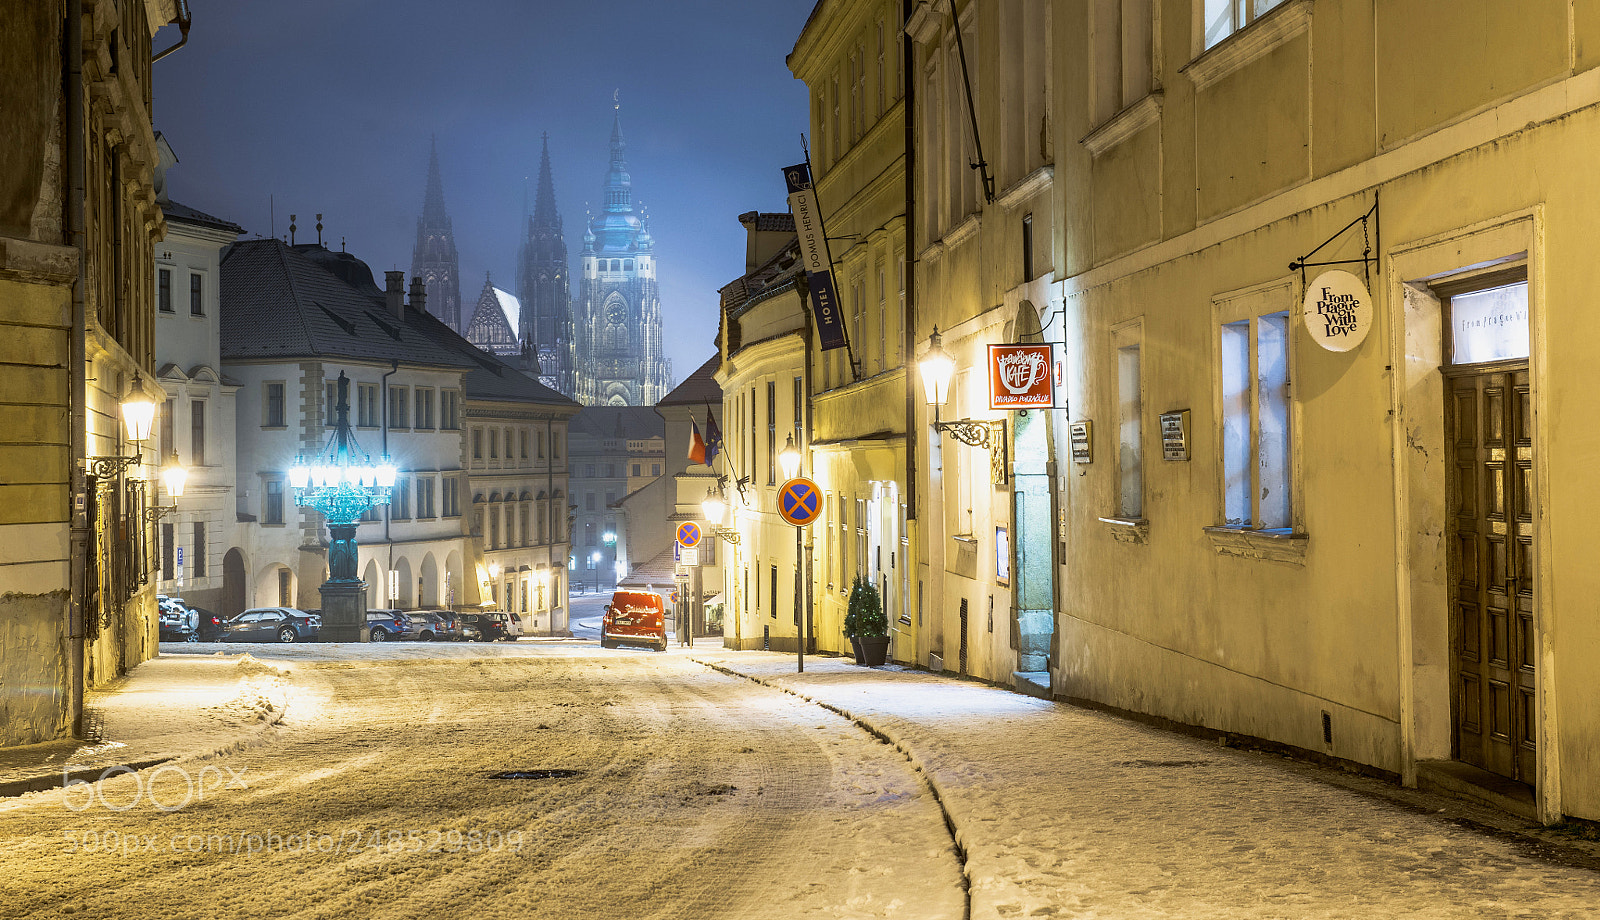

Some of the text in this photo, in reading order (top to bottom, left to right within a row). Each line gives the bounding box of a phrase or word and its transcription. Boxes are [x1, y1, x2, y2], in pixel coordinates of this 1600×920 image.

[798, 194, 821, 268] DOMUS HENRICI
[1321, 287, 1354, 303] From
[818, 287, 833, 325] HOTEL
[1316, 299, 1360, 317] Prague
[1322, 311, 1357, 326] With
[1324, 323, 1357, 337] Love
